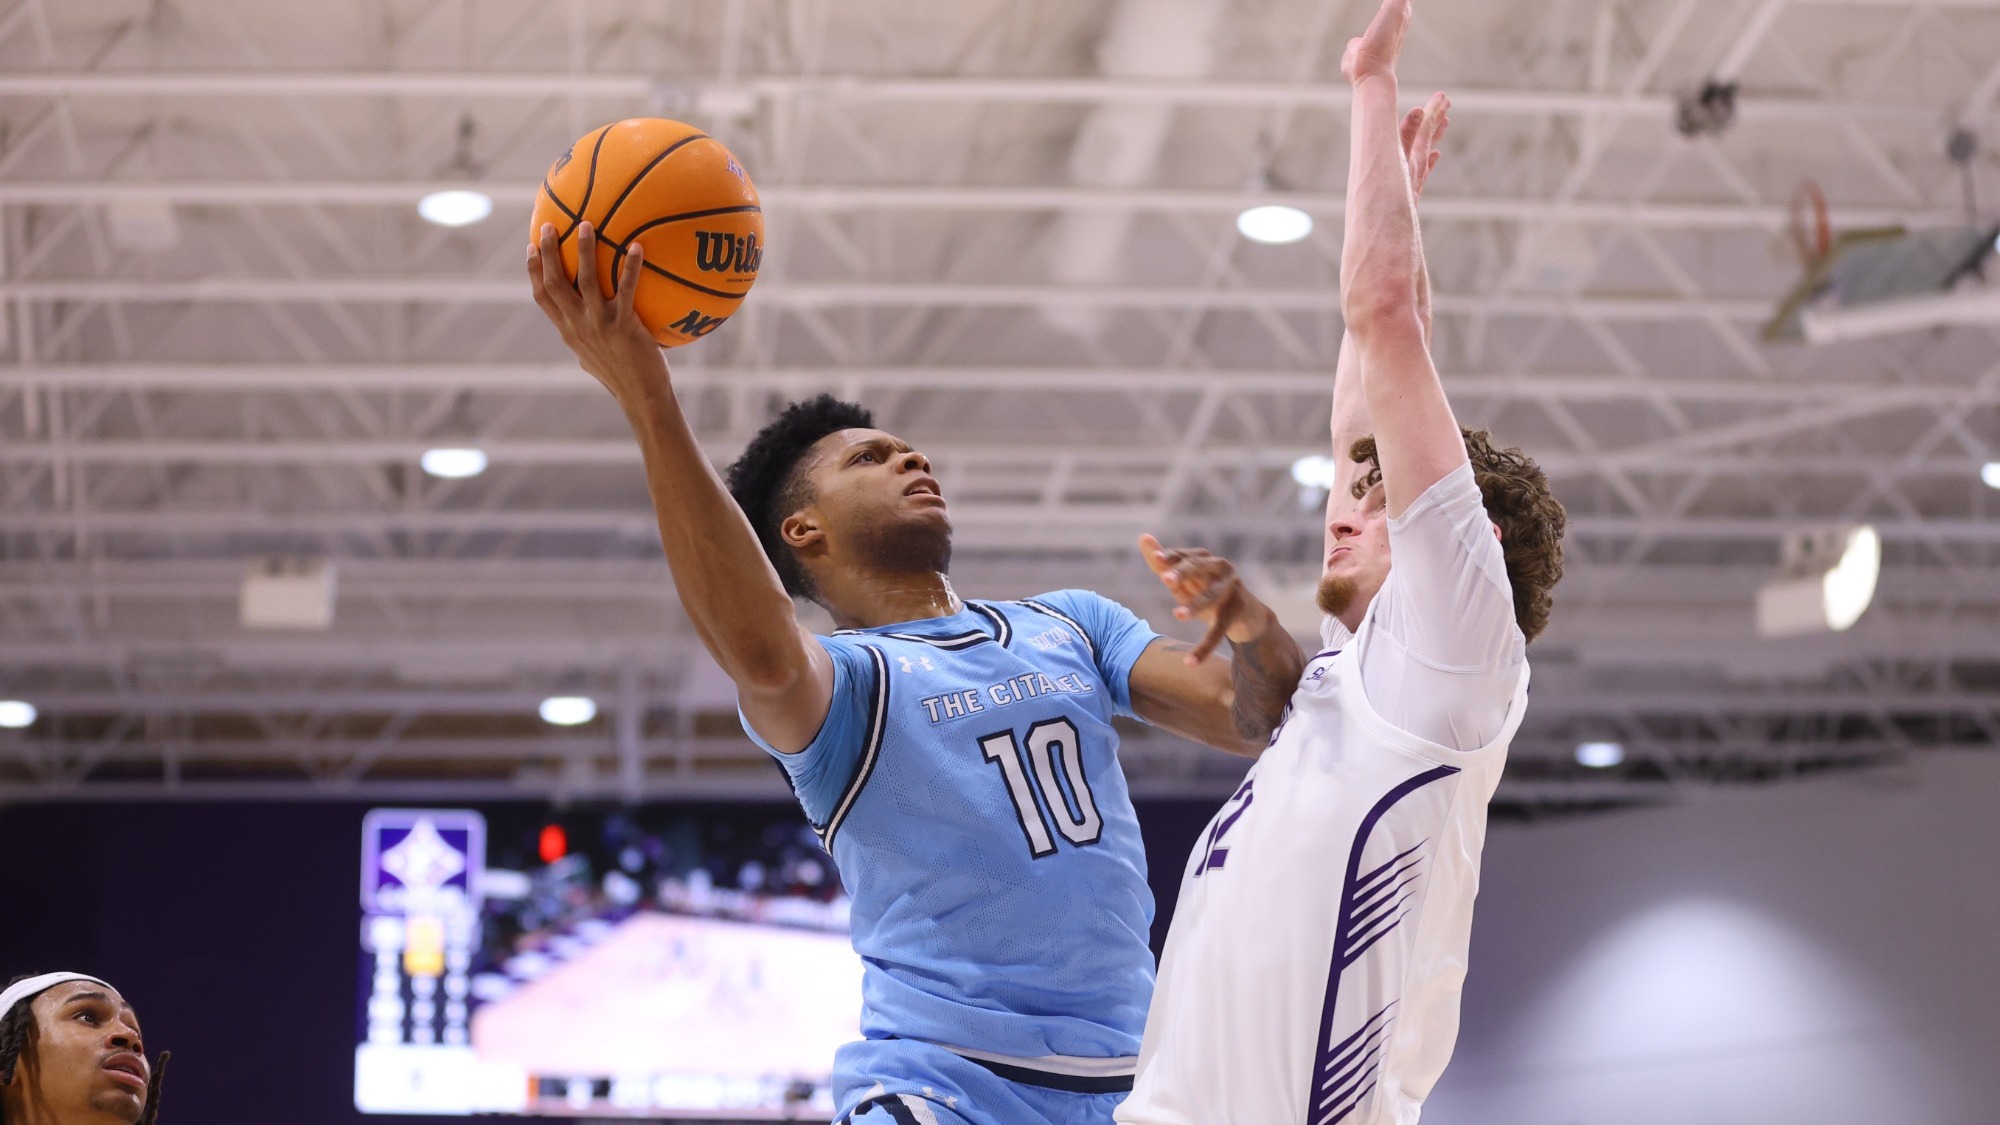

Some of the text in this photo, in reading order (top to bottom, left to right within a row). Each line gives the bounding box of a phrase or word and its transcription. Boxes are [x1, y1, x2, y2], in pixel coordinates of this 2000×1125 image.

[669, 309, 729, 337] NC
[922, 689, 984, 723] THE
[976, 715, 1104, 860] 10
